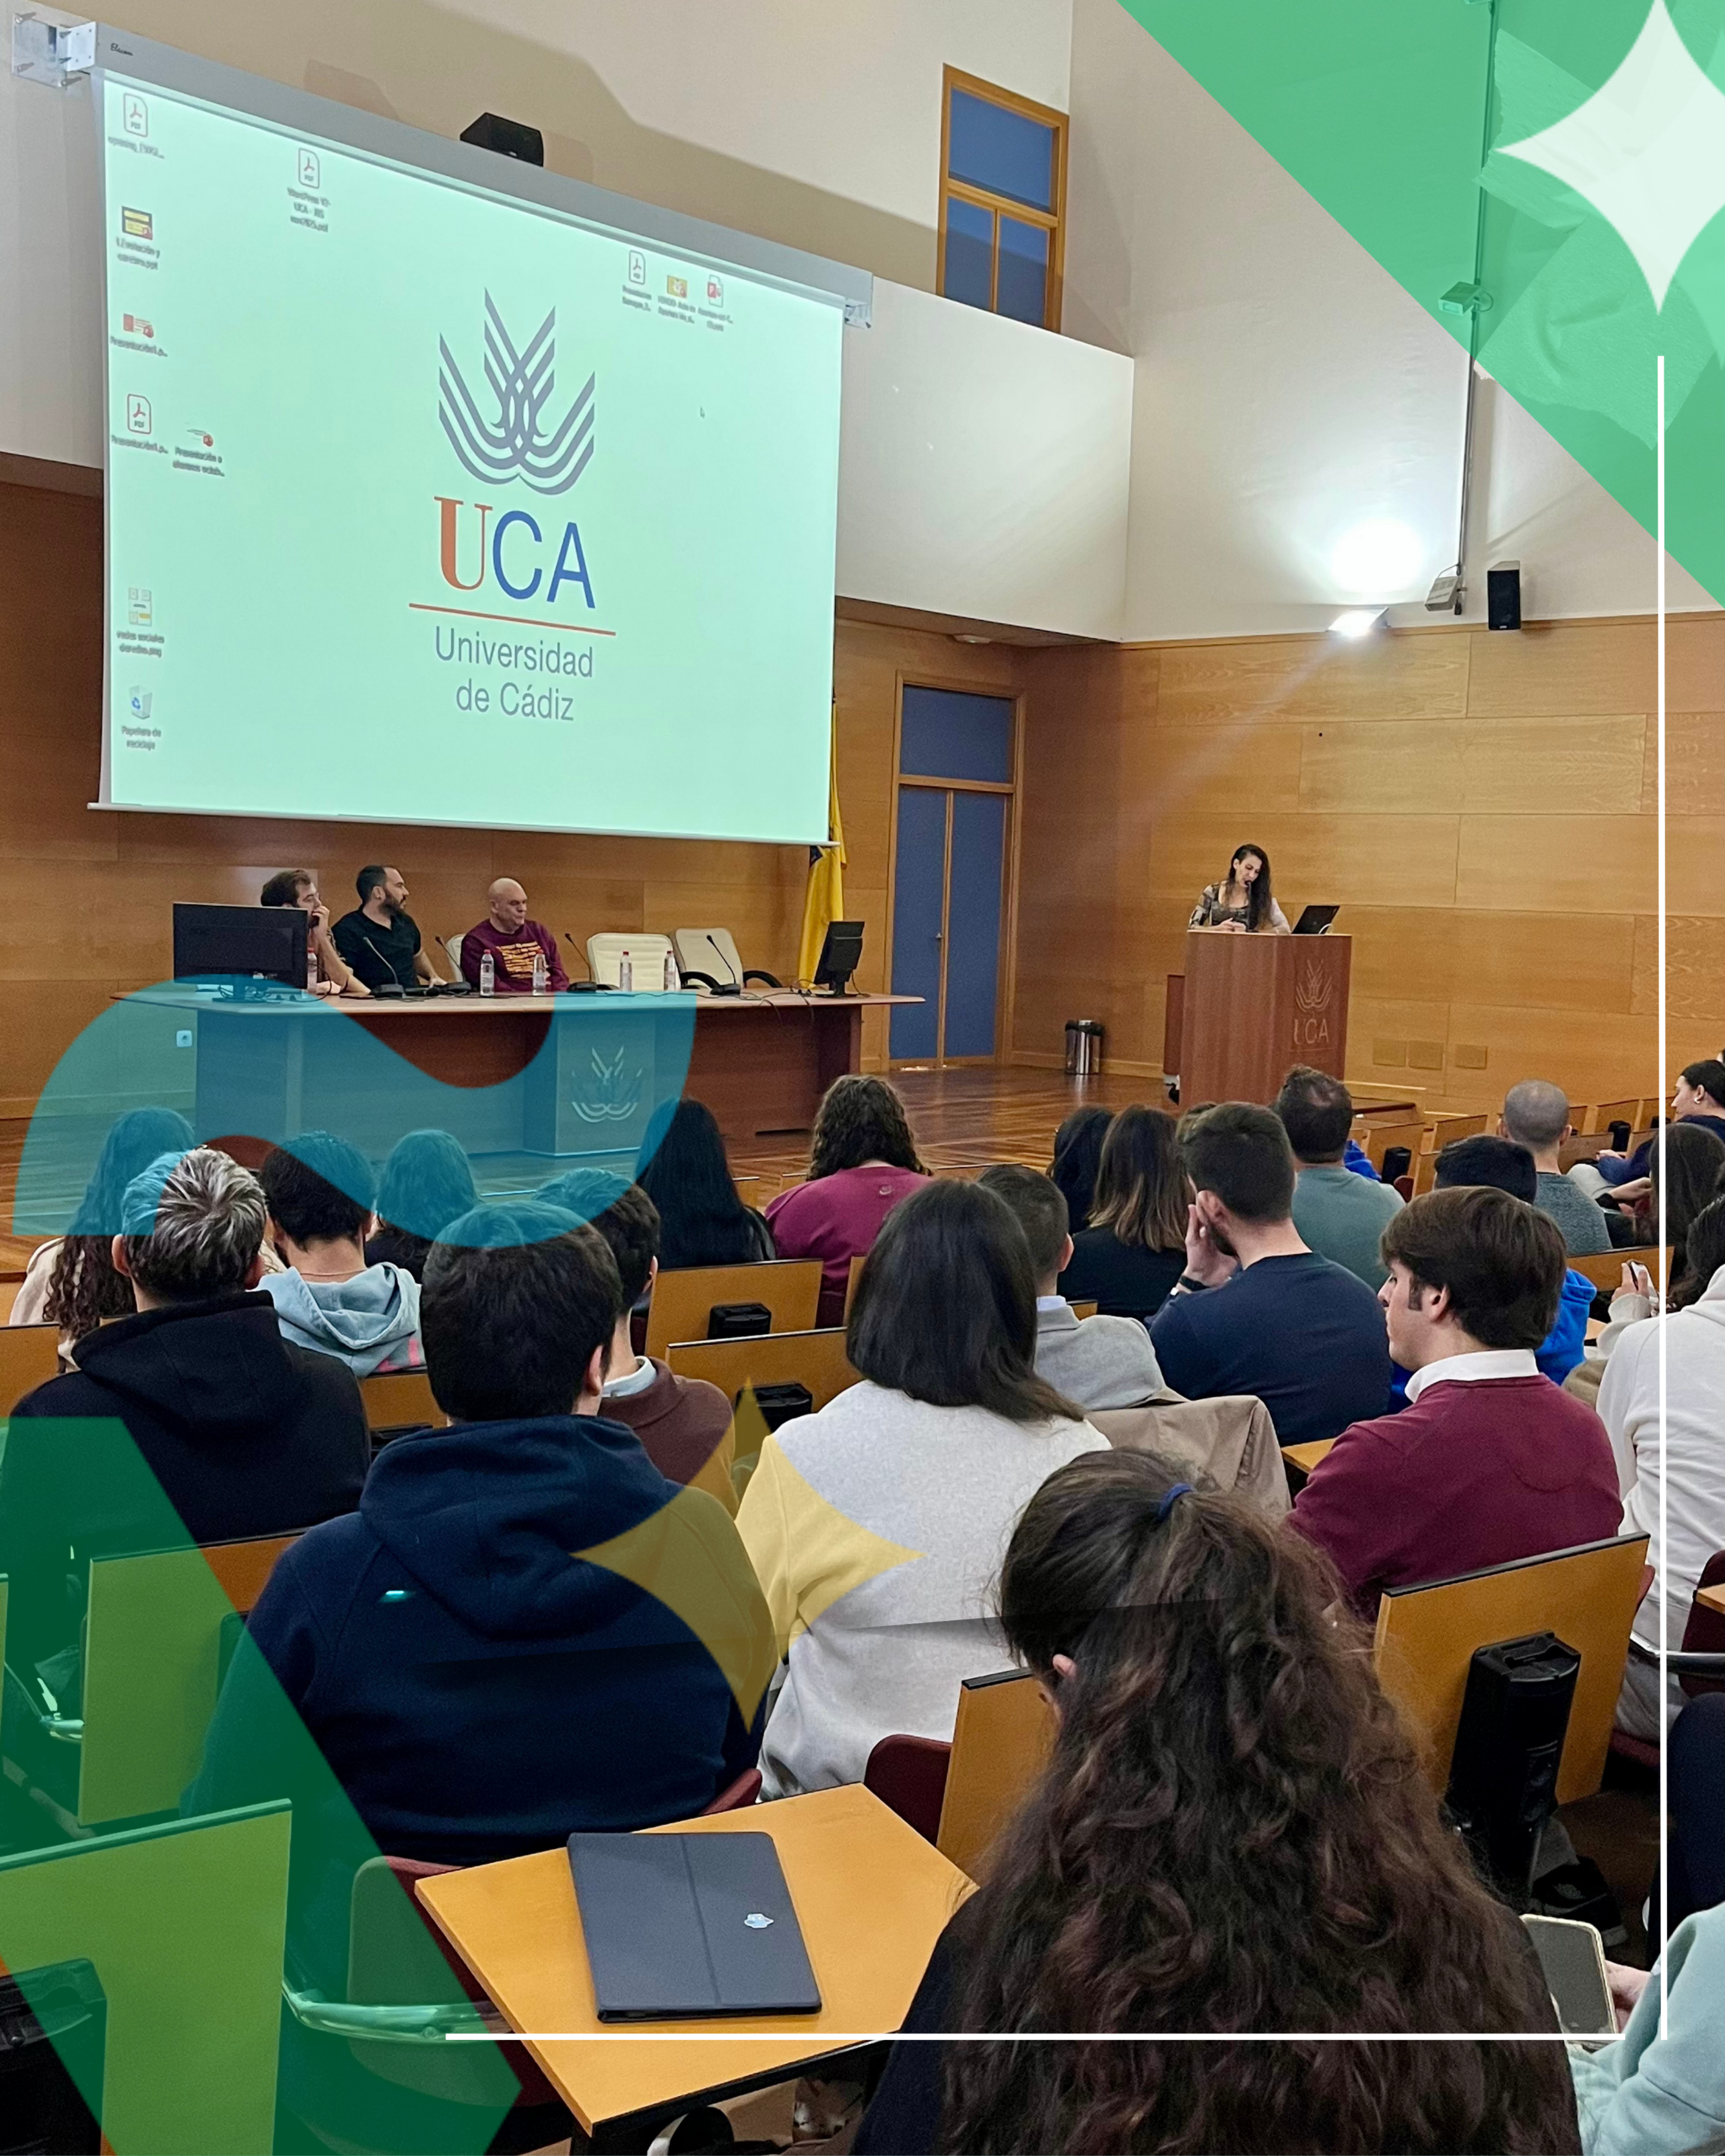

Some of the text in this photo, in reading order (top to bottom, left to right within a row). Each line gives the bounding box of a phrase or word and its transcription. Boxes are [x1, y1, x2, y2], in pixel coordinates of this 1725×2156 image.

[434, 496, 595, 609] UCA
[436, 626, 592, 678] Universidad
[456, 678, 573, 721] de Cádiz
[1294, 1018, 1329, 1046] UCA
